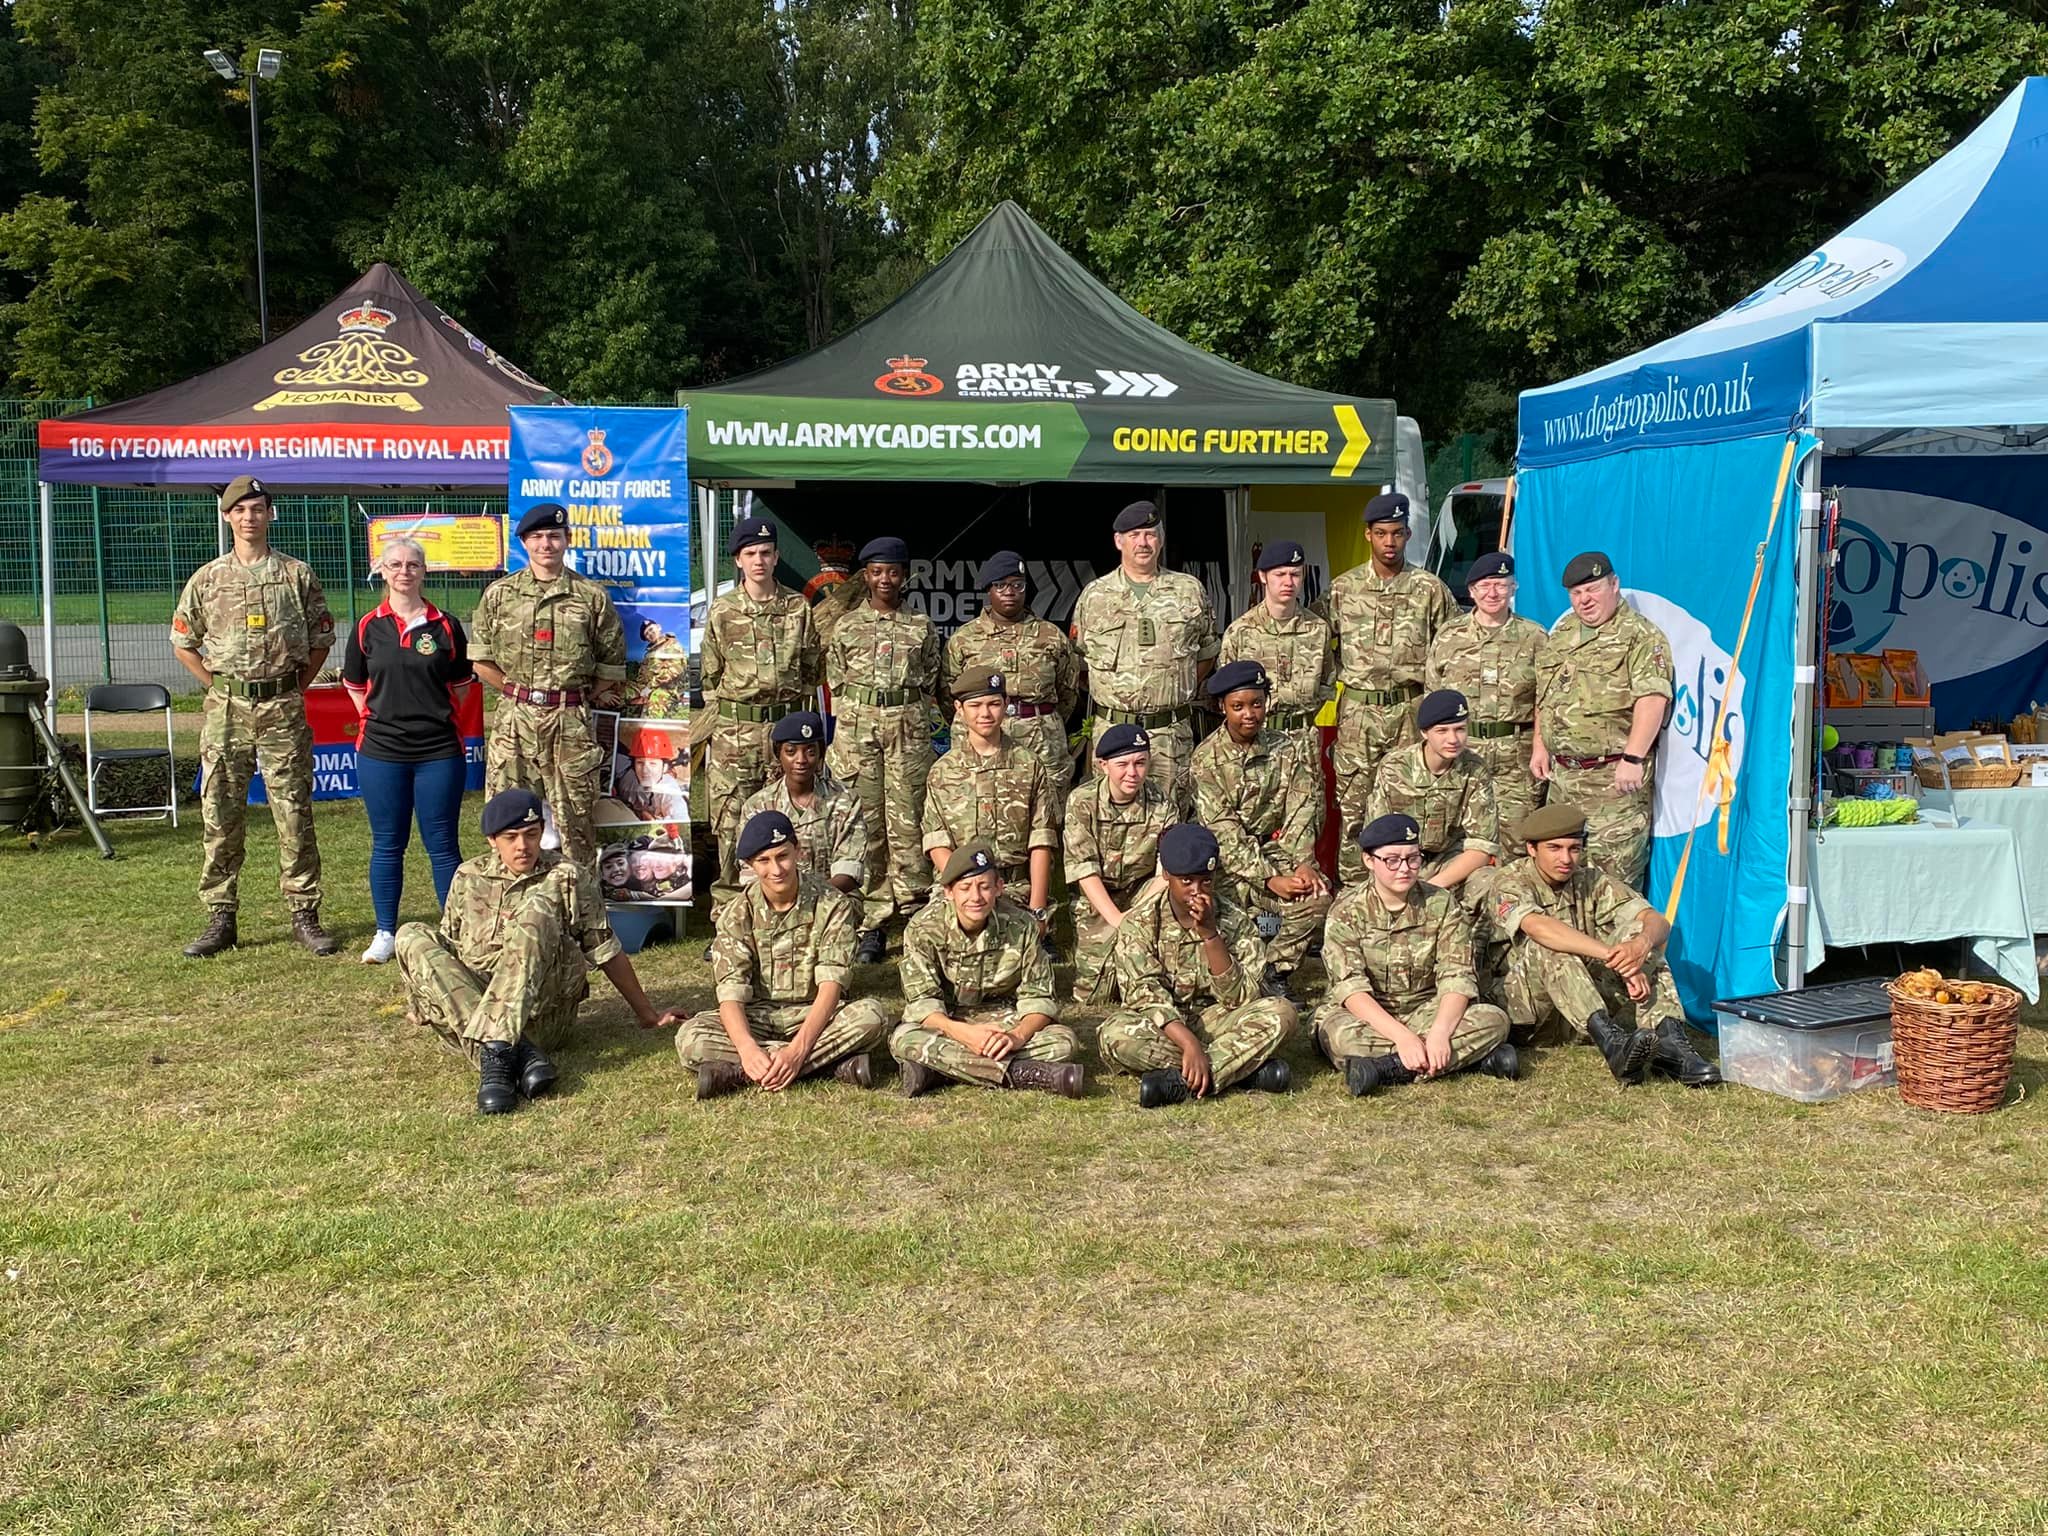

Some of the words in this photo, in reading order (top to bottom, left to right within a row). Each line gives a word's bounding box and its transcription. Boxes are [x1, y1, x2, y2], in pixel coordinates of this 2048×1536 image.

[955, 362, 1062, 380] ARMY
[281, 391, 398, 404] YEOMANRY
[957, 378, 1097, 395] CADETS
[1544, 361, 1754, 447] www.dogtropolis.co.uk
[706, 420, 1041, 448] WWW.ARMYCADETS.COM
[1113, 427, 1196, 452] GOING
[1203, 430, 1329, 454] FURTHER
[68, 437, 105, 457] 106
[110, 437, 253, 461] (YEOMANRY)
[259, 437, 376, 459] REGIMENT
[383, 438, 455, 460] ROYAL
[460, 439, 510, 460] ARTI
[520, 479, 564, 497] ARMY
[568, 479, 621, 498] CADET
[624, 480, 671, 498] FORCE
[568, 504, 623, 527] MAKE
[596, 527, 652, 549] MARK
[582, 550, 666, 577] TODAY!
